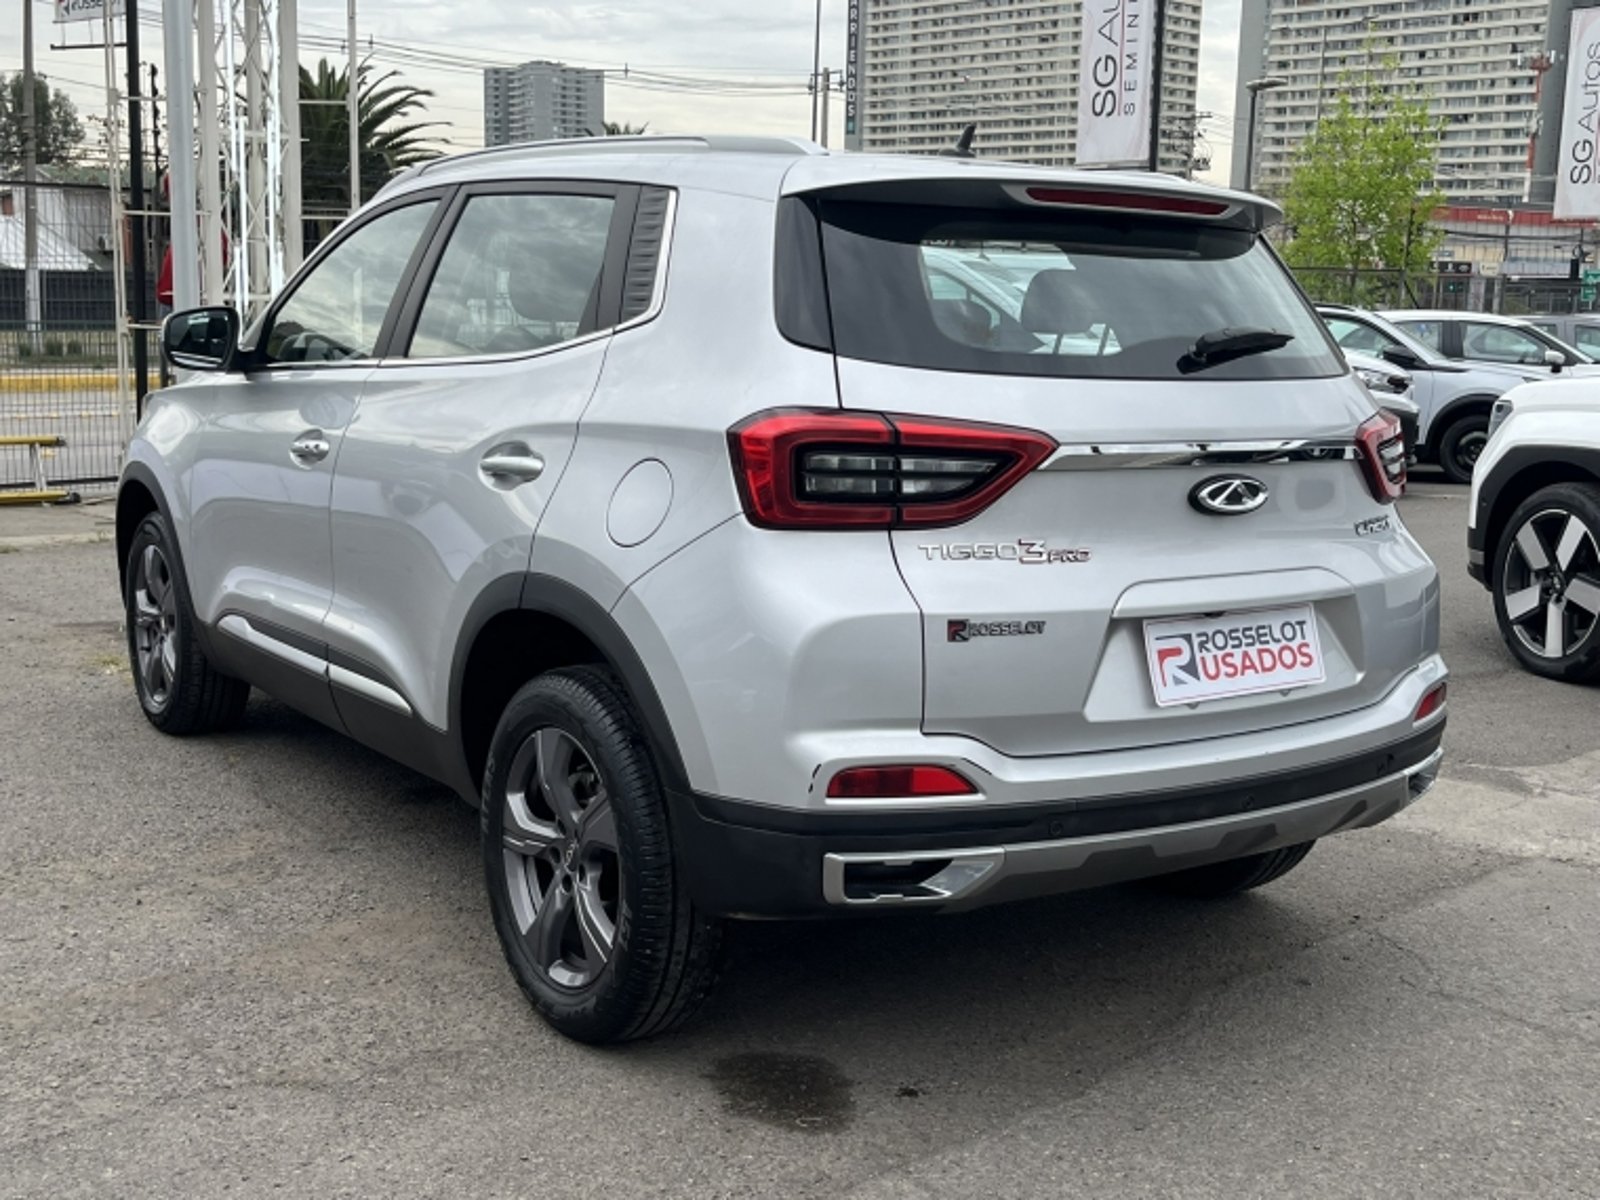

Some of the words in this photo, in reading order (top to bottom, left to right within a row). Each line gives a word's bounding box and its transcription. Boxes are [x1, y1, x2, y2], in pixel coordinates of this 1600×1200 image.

[1124, 0, 1140, 116] SEMIN
[1092, 54, 1118, 117] SG
[1570, 139, 1595, 184] SG
[1197, 620, 1306, 654] ROSSELOT
[1200, 642, 1313, 681] USADOS
